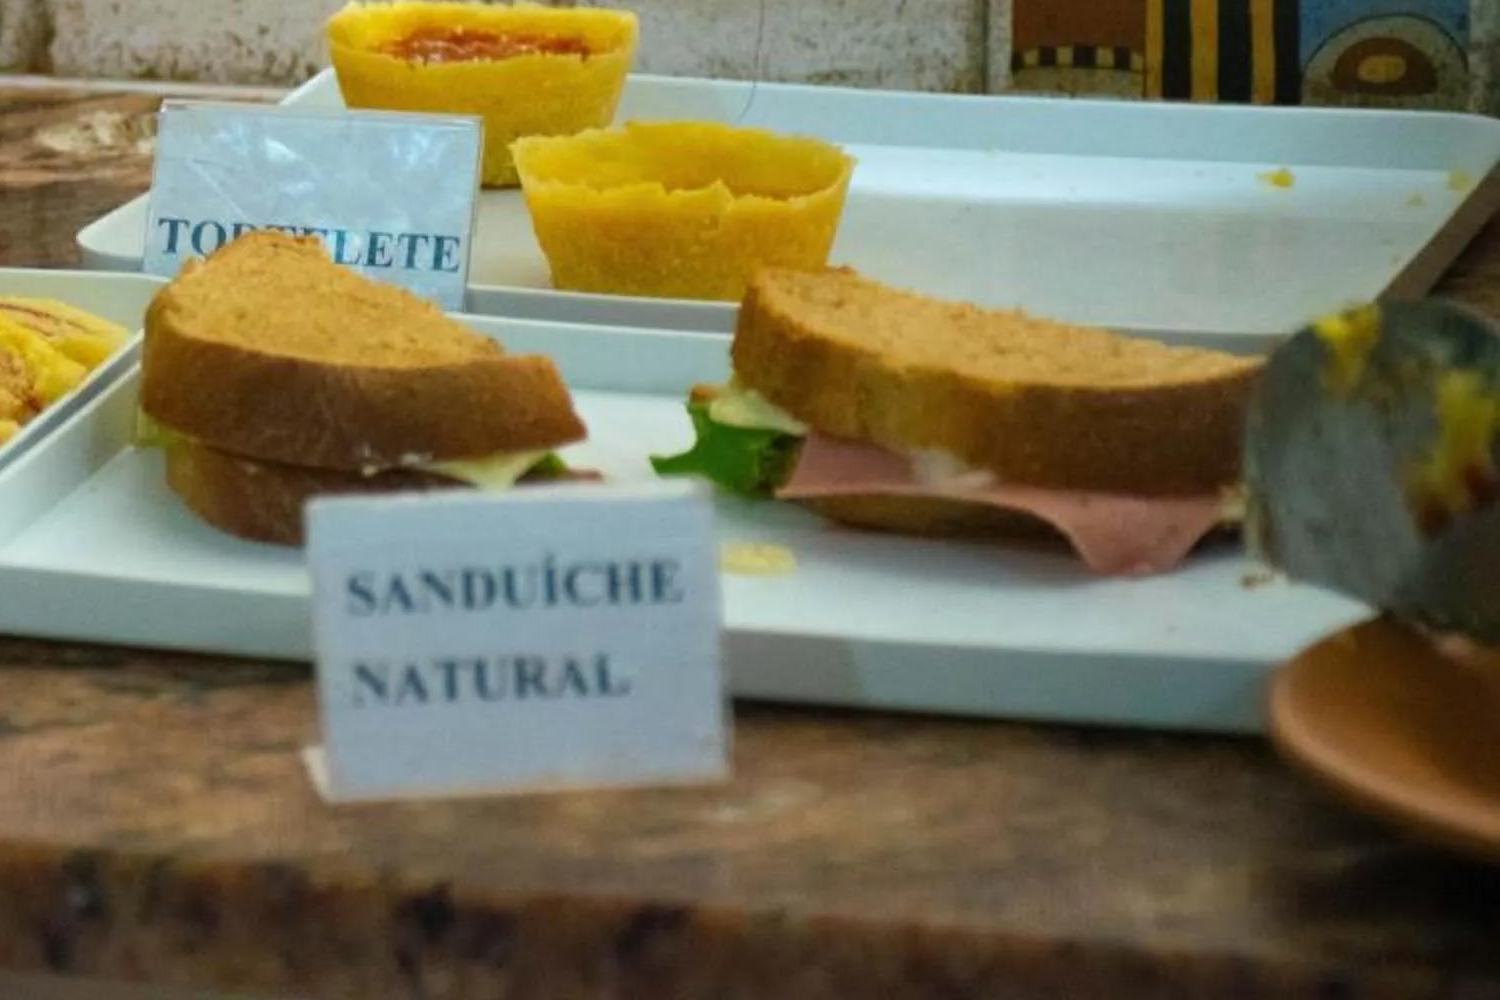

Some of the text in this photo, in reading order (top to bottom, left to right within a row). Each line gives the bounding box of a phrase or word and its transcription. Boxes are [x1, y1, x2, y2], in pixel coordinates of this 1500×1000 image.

[158, 218, 461, 273] TOLETE
[346, 550, 684, 617] SANDUÍCHE
[352, 650, 632, 708] NATURAL
